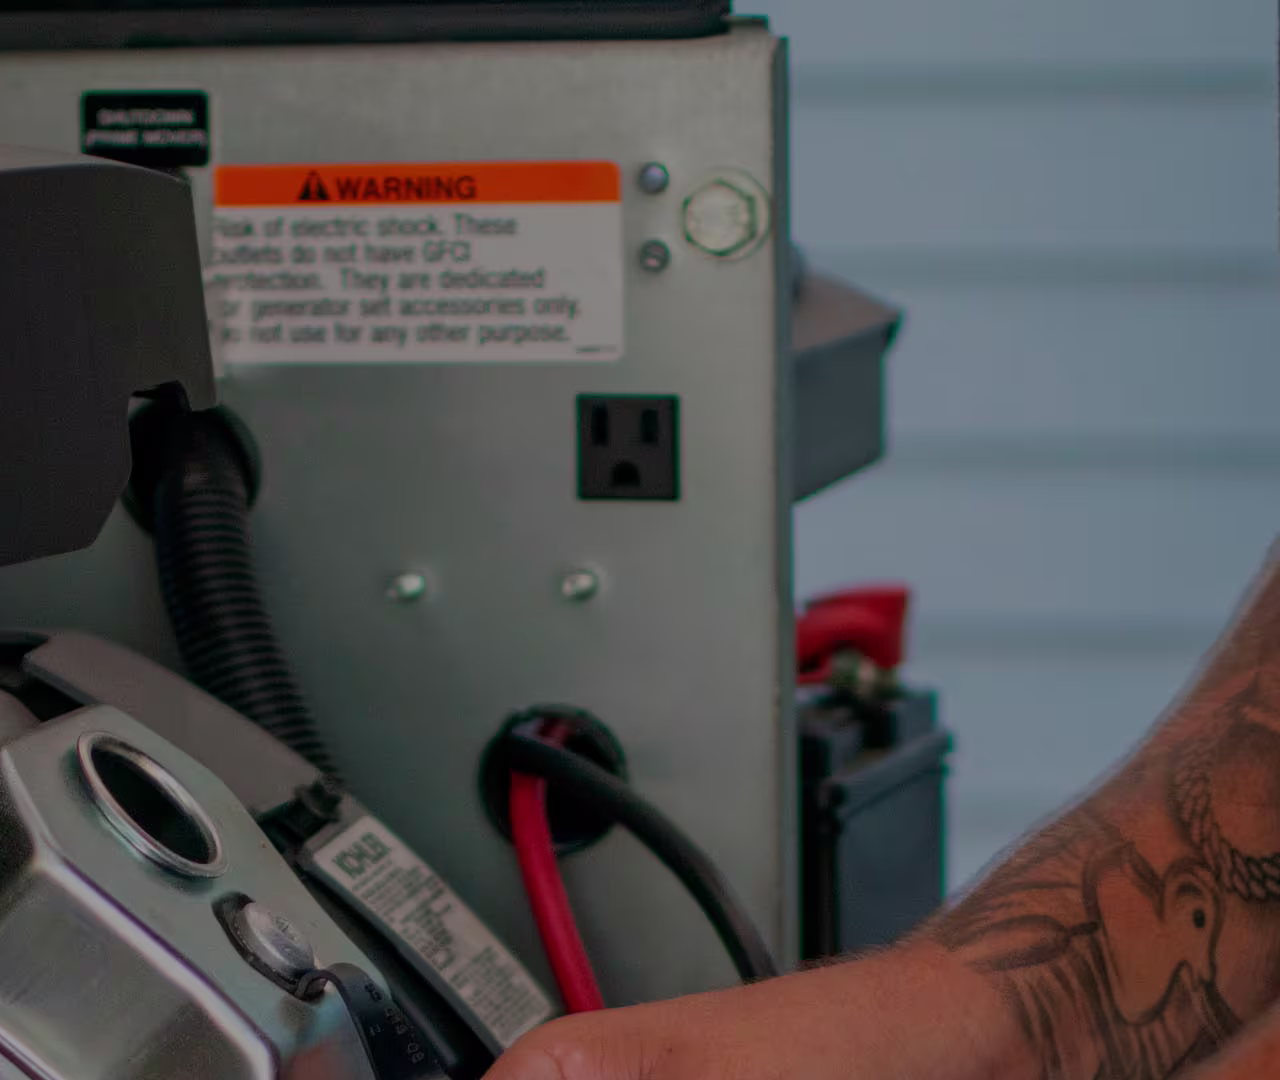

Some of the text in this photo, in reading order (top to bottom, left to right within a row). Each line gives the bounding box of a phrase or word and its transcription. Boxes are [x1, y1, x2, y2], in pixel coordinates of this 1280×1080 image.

[335, 174, 478, 200] WARNING
[264, 213, 283, 237] of
[291, 213, 368, 237] electric
[376, 213, 444, 237] shock.
[452, 212, 519, 236] These
[291, 241, 316, 264] do
[323, 242, 358, 264] not
[364, 241, 415, 264] have
[340, 266, 389, 294] They
[398, 271, 430, 291] are
[439, 265, 546, 290] dedicated
[252, 297, 352, 320] generator
[359, 296, 392, 317] set
[399, 297, 525, 317] accessories
[250, 321, 283, 345] not
[290, 326, 327, 345] use
[333, 322, 363, 345] for
[371, 325, 408, 349] any
[416, 321, 469, 345] other
